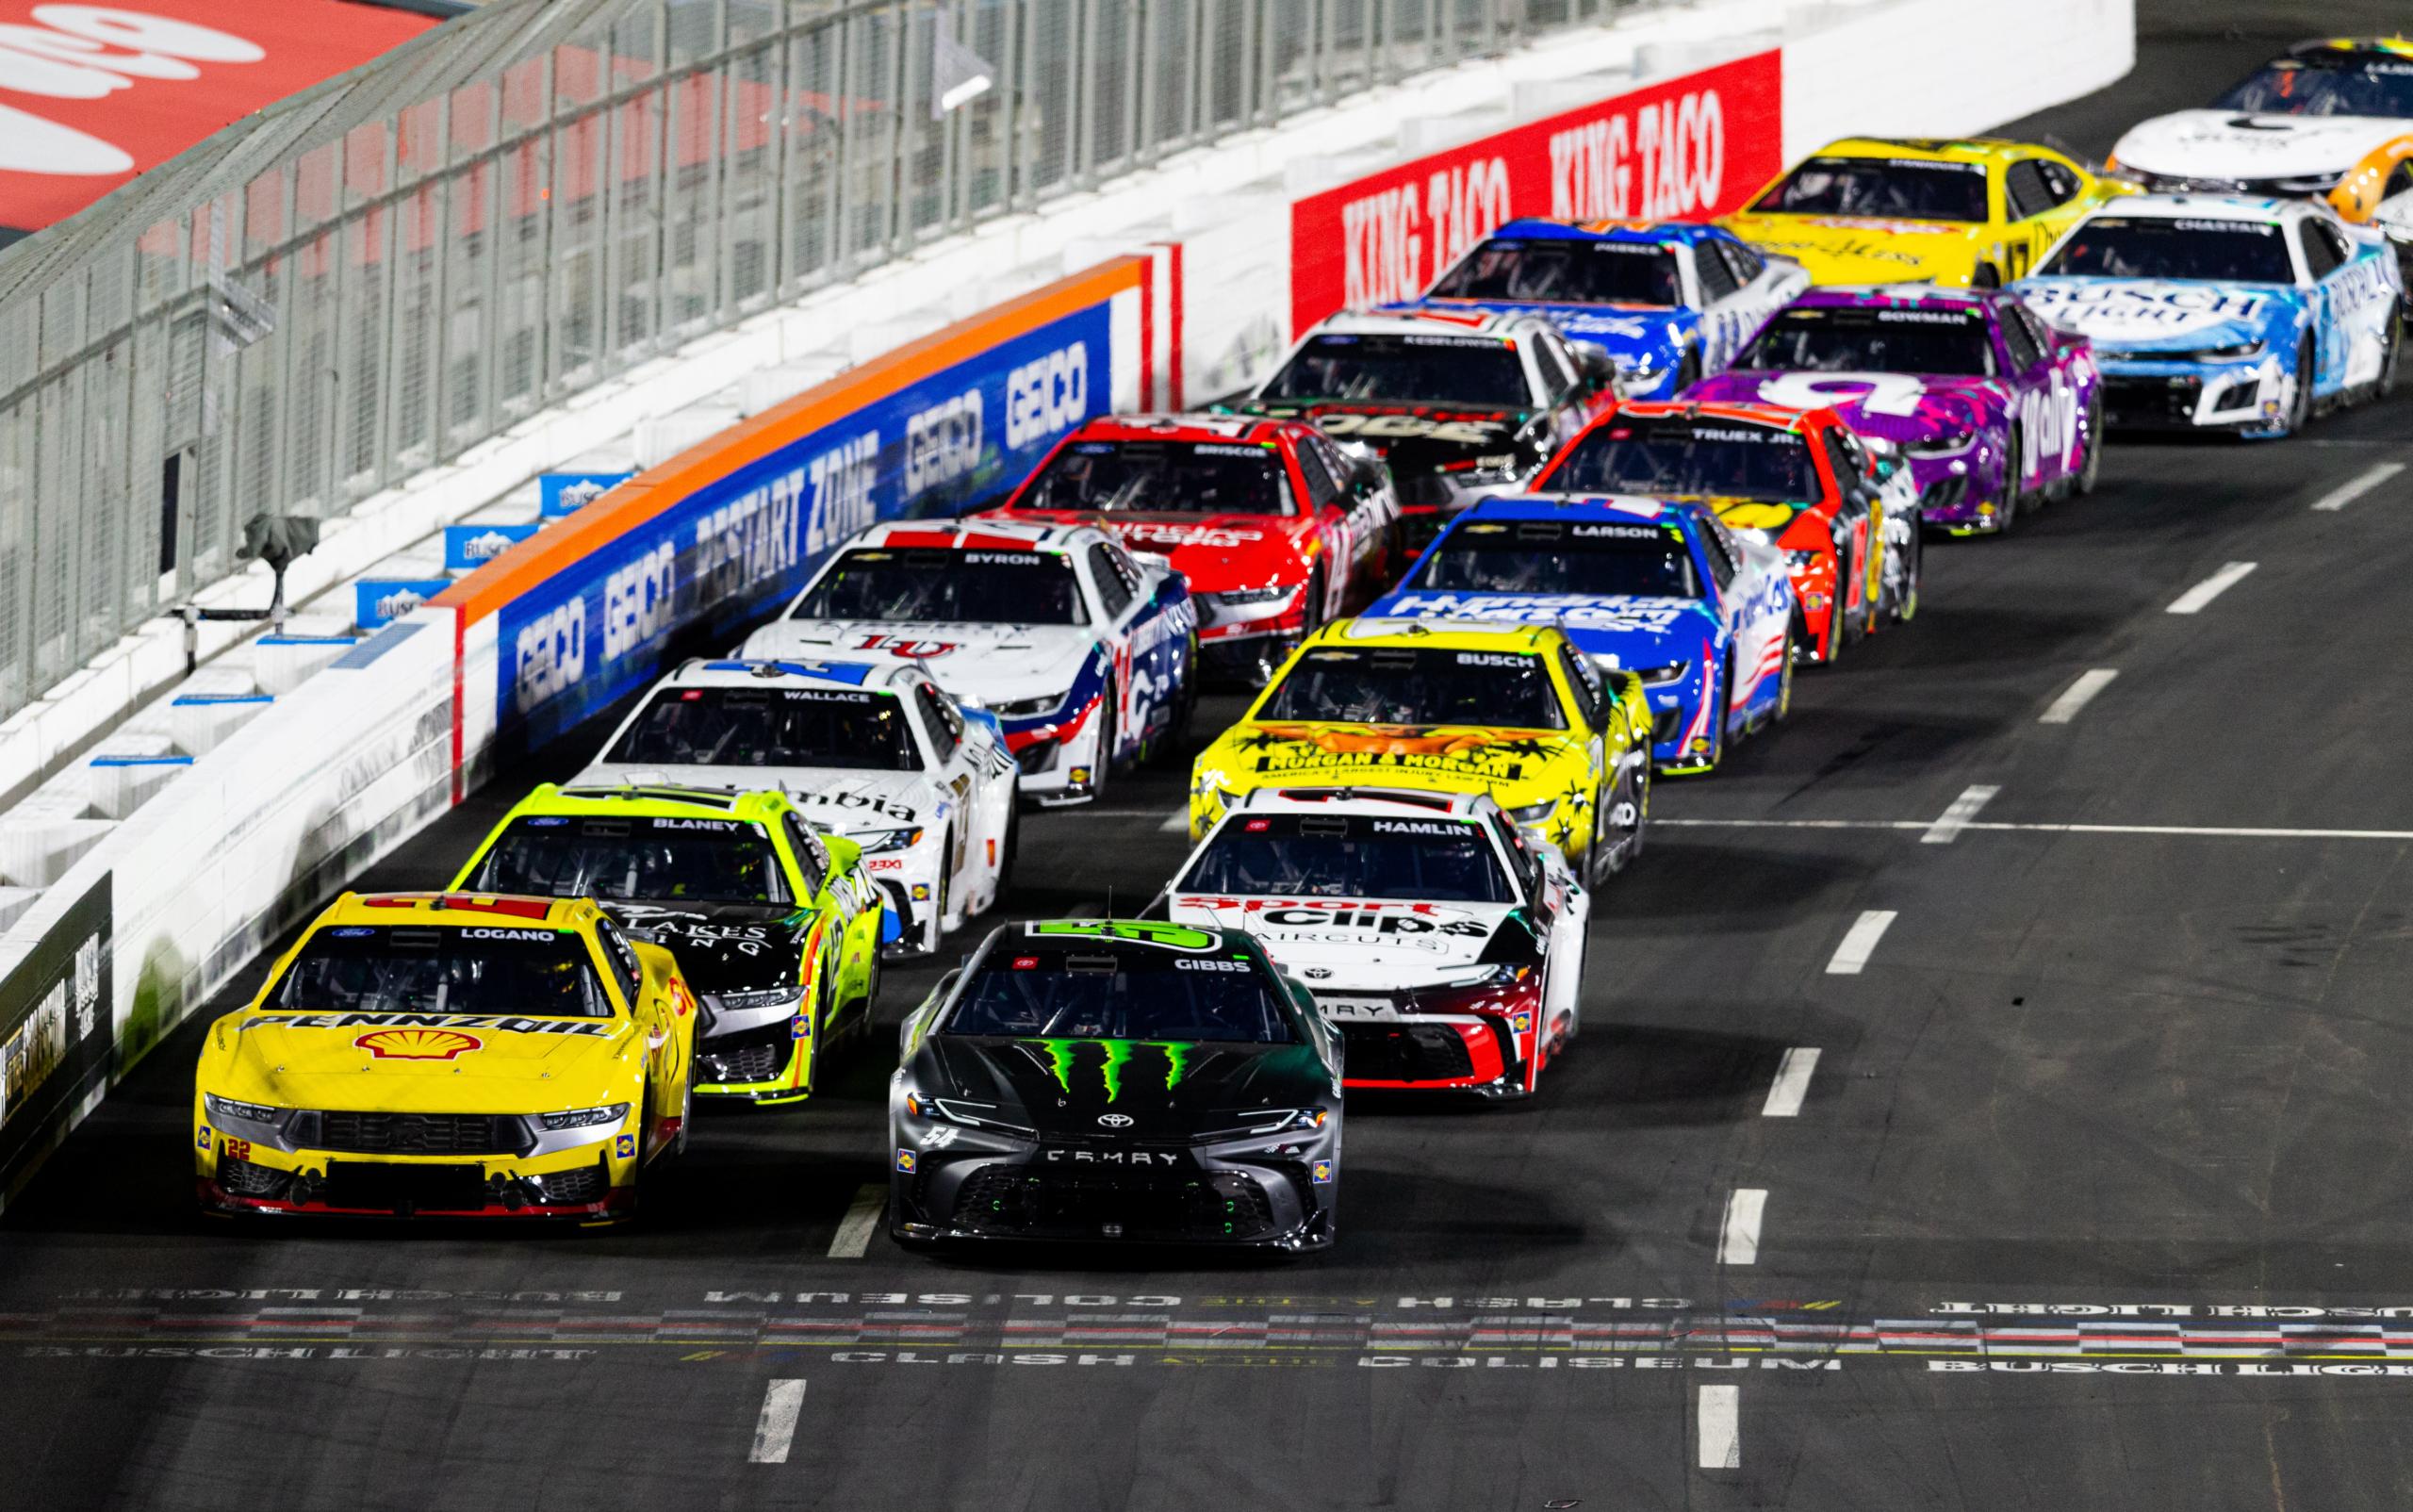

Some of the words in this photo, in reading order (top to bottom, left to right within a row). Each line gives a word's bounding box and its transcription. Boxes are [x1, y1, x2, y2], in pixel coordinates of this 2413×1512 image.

[1550, 113, 1631, 219] KING
[1637, 90, 1724, 220] TACO
[1343, 184, 1421, 312] KING
[1428, 156, 1511, 283] TACO
[1006, 340, 1087, 451] GEICO
[905, 388, 982, 498] GEICO
[1692, 428, 1763, 442] TRUEX
[561, 489, 601, 507] BUSC
[695, 468, 804, 609] RESTART
[807, 429, 879, 557] ZONE
[1572, 526, 1659, 538] LARSON
[465, 542, 510, 558] BUSC
[964, 552, 1041, 566] BYRON
[376, 599, 421, 618] BUSC
[604, 540, 675, 662] GEICO
[517, 595, 585, 715] GEICO
[1456, 652, 1535, 667] BUSCH
[783, 691, 871, 703] WALLACE
[1267, 753, 1374, 770] MORGAN
[1403, 754, 1509, 779] MORGAN
[652, 817, 740, 831] BLANEY
[1372, 821, 1473, 836] HAMLIN
[1178, 896, 1440, 917] Sport
[1263, 910, 1490, 938] Clips
[460, 928, 555, 942] LOGANO
[1255, 931, 1438, 951] AIRCUTS
[1174, 958, 1252, 973] GIBBS
[236, 1014, 615, 1039] PENNZOIL
[919, 1124, 960, 1148] 54
[227, 1138, 251, 1161] 22
[1046, 1149, 1177, 1165] CAMRY
[830, 1352, 1135, 1365] CLASH
[1357, 1357, 1844, 1370] COLISEUM
[1927, 1360, 2223, 1375] BUSCH
